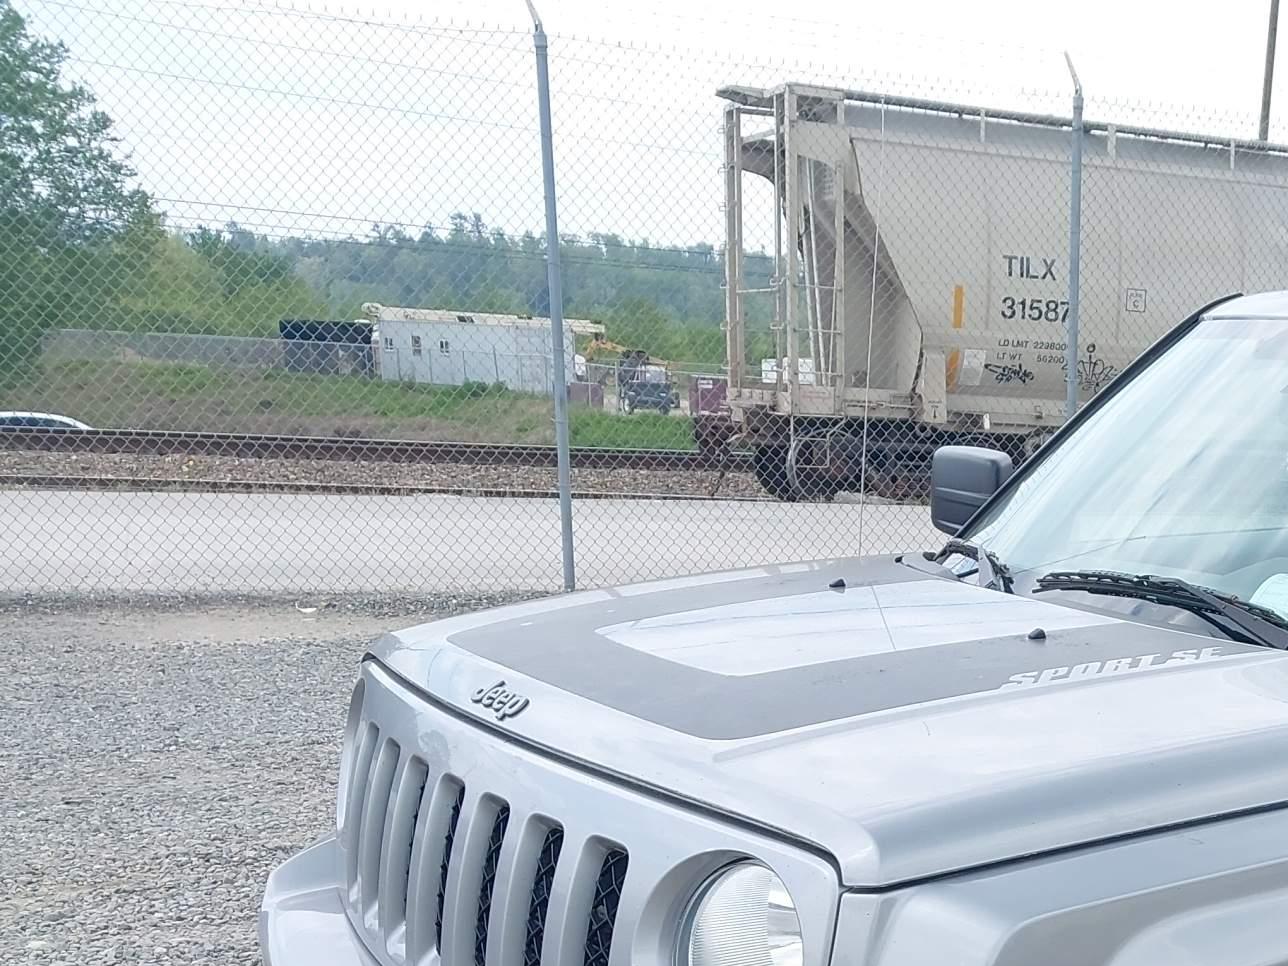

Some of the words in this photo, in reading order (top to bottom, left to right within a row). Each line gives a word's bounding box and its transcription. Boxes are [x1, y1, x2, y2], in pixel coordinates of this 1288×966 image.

[1002, 254, 1057, 281] TILX
[1011, 340, 1029, 349] LMT
[1002, 654, 1161, 689] SPORT
[1163, 646, 1223, 666] SE
[470, 680, 530, 721] Jeep
